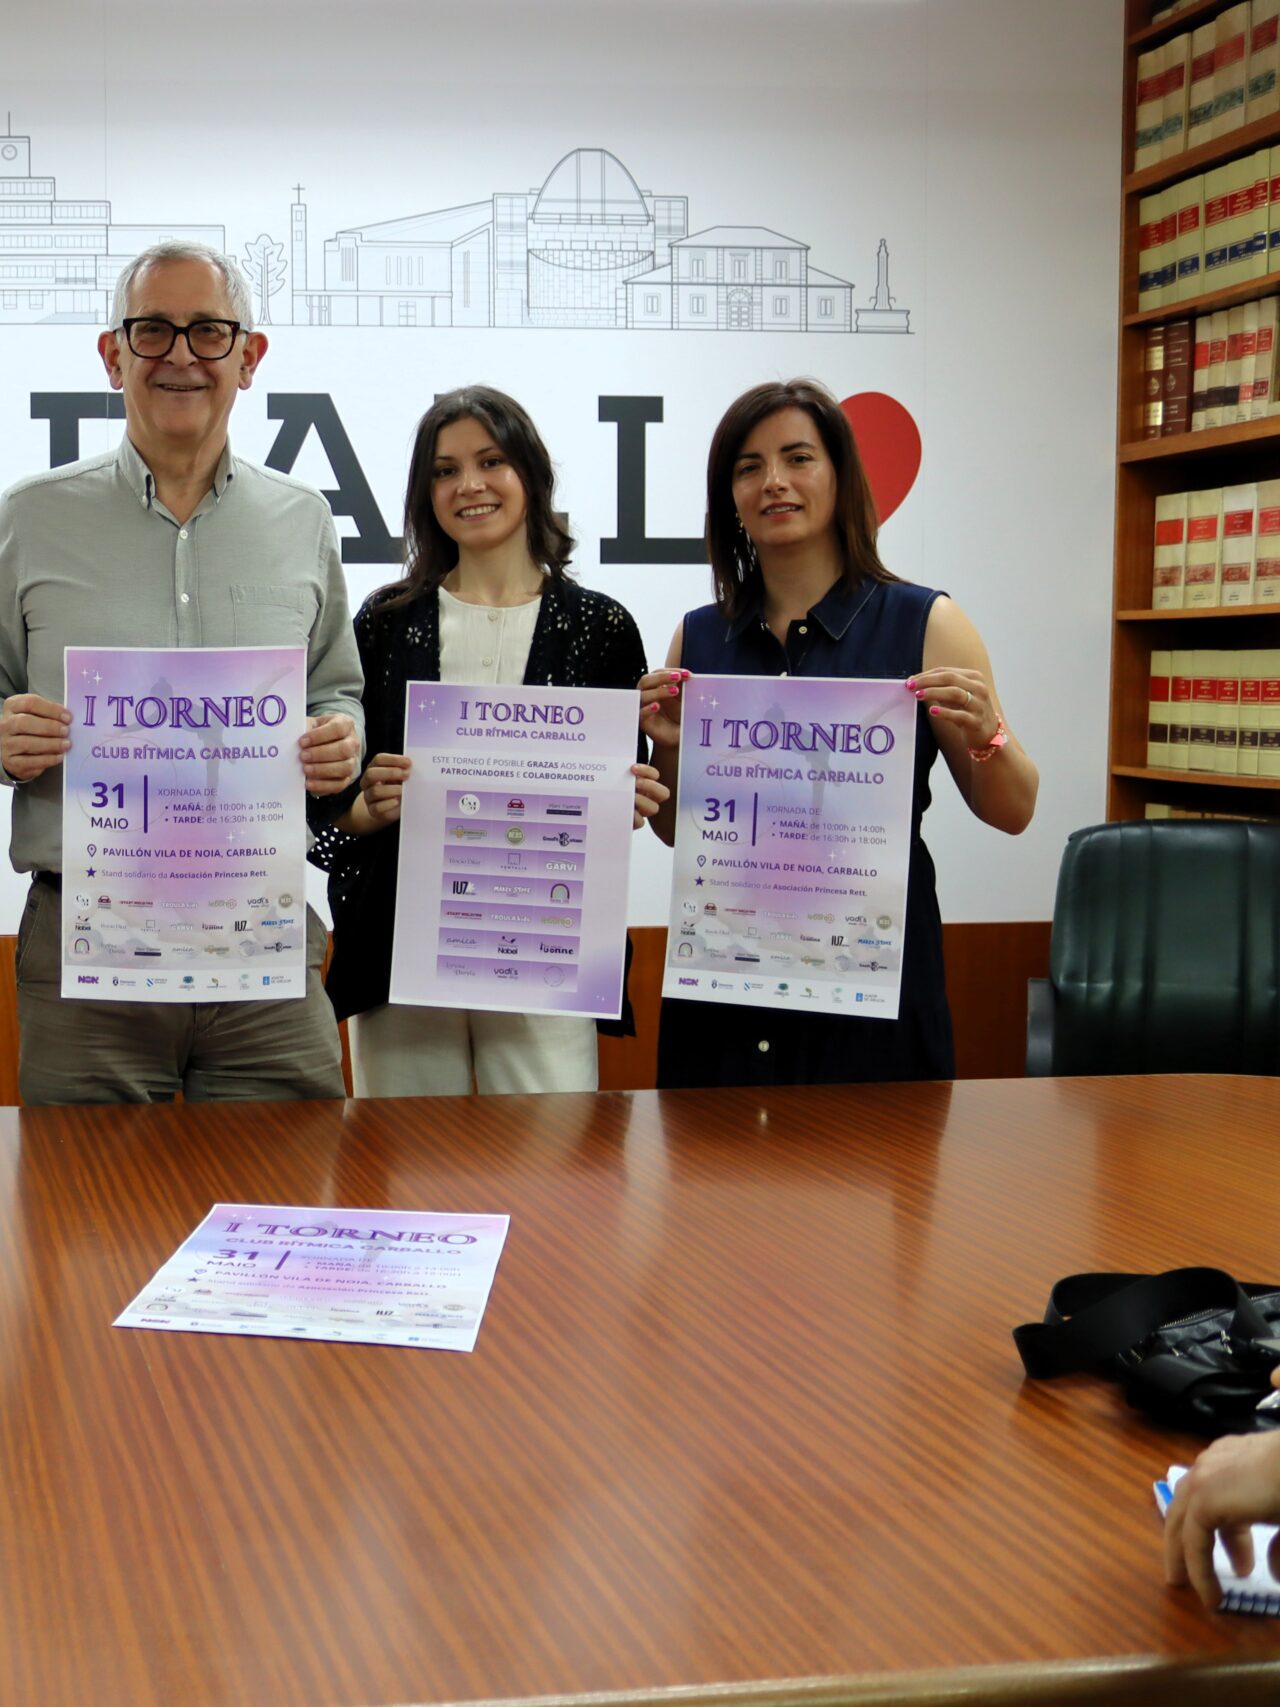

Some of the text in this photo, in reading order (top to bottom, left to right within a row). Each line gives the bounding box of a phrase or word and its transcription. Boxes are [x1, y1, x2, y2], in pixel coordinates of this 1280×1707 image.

[83, 695, 286, 728] I TORNEO
[460, 701, 584, 725] I TORNEO
[456, 727, 586, 742] CLUB RÍTMICA CARBALLO
[699, 718, 894, 754] I TORNEO
[91, 744, 278, 760] CLUB RÍTMICA CARBALLO
[452, 757, 484, 766] TORNEO
[486, 757, 492, 766] É
[493, 758, 525, 768] POSIBLE
[527, 760, 558, 769] GRAZAS
[560, 762, 577, 770] AOS
[578, 764, 607, 772] NOSOS
[440, 767, 514, 777] PATROCINADORES
[522, 772, 594, 782] COLABORADORES
[706, 764, 884, 784] CLUB RÍTMICA CARBALLO
[92, 782, 124, 809] 31
[158, 788, 215, 797] XORNADA DE:
[173, 802, 201, 811] MAÑÁ:
[206, 803, 216, 812] de
[219, 803, 246, 812] 10:00h
[256, 801, 282, 809] 14:00h
[704, 798, 736, 823] 31
[91, 817, 129, 830] MAIO
[173, 816, 204, 824] TARDE:
[206, 815, 217, 824] de
[219, 815, 247, 824] 16:30h
[256, 813, 284, 822] 18:00H
[780, 820, 806, 828] MAÑÁ:
[810, 822, 820, 830] de
[822, 822, 849, 831] 10:00h
[859, 825, 885, 834] 14:00h
[702, 830, 738, 842] MAIO
[780, 832, 808, 840] TARDE:
[810, 833, 820, 841] de
[822, 834, 849, 842] 16:30h
[859, 836, 886, 845] 18:00H
[103, 847, 276, 858] PAVILLÓN VILA DE NOIA, CARBALLO
[545, 861, 577, 871] GARVI
[712, 858, 877, 877] PAVILLÓN VILA DE NOIA, CARBALLO
[101, 870, 123, 878] Stand
[124, 870, 157, 879] solidario
[224, 1222, 478, 1244] I TORNEO
[278, 1240, 354, 1250] RÍTMICA
[360, 1244, 461, 1254] CARBALLO
[213, 1249, 258, 1260] 31
[207, 1260, 256, 1268] MAIO
